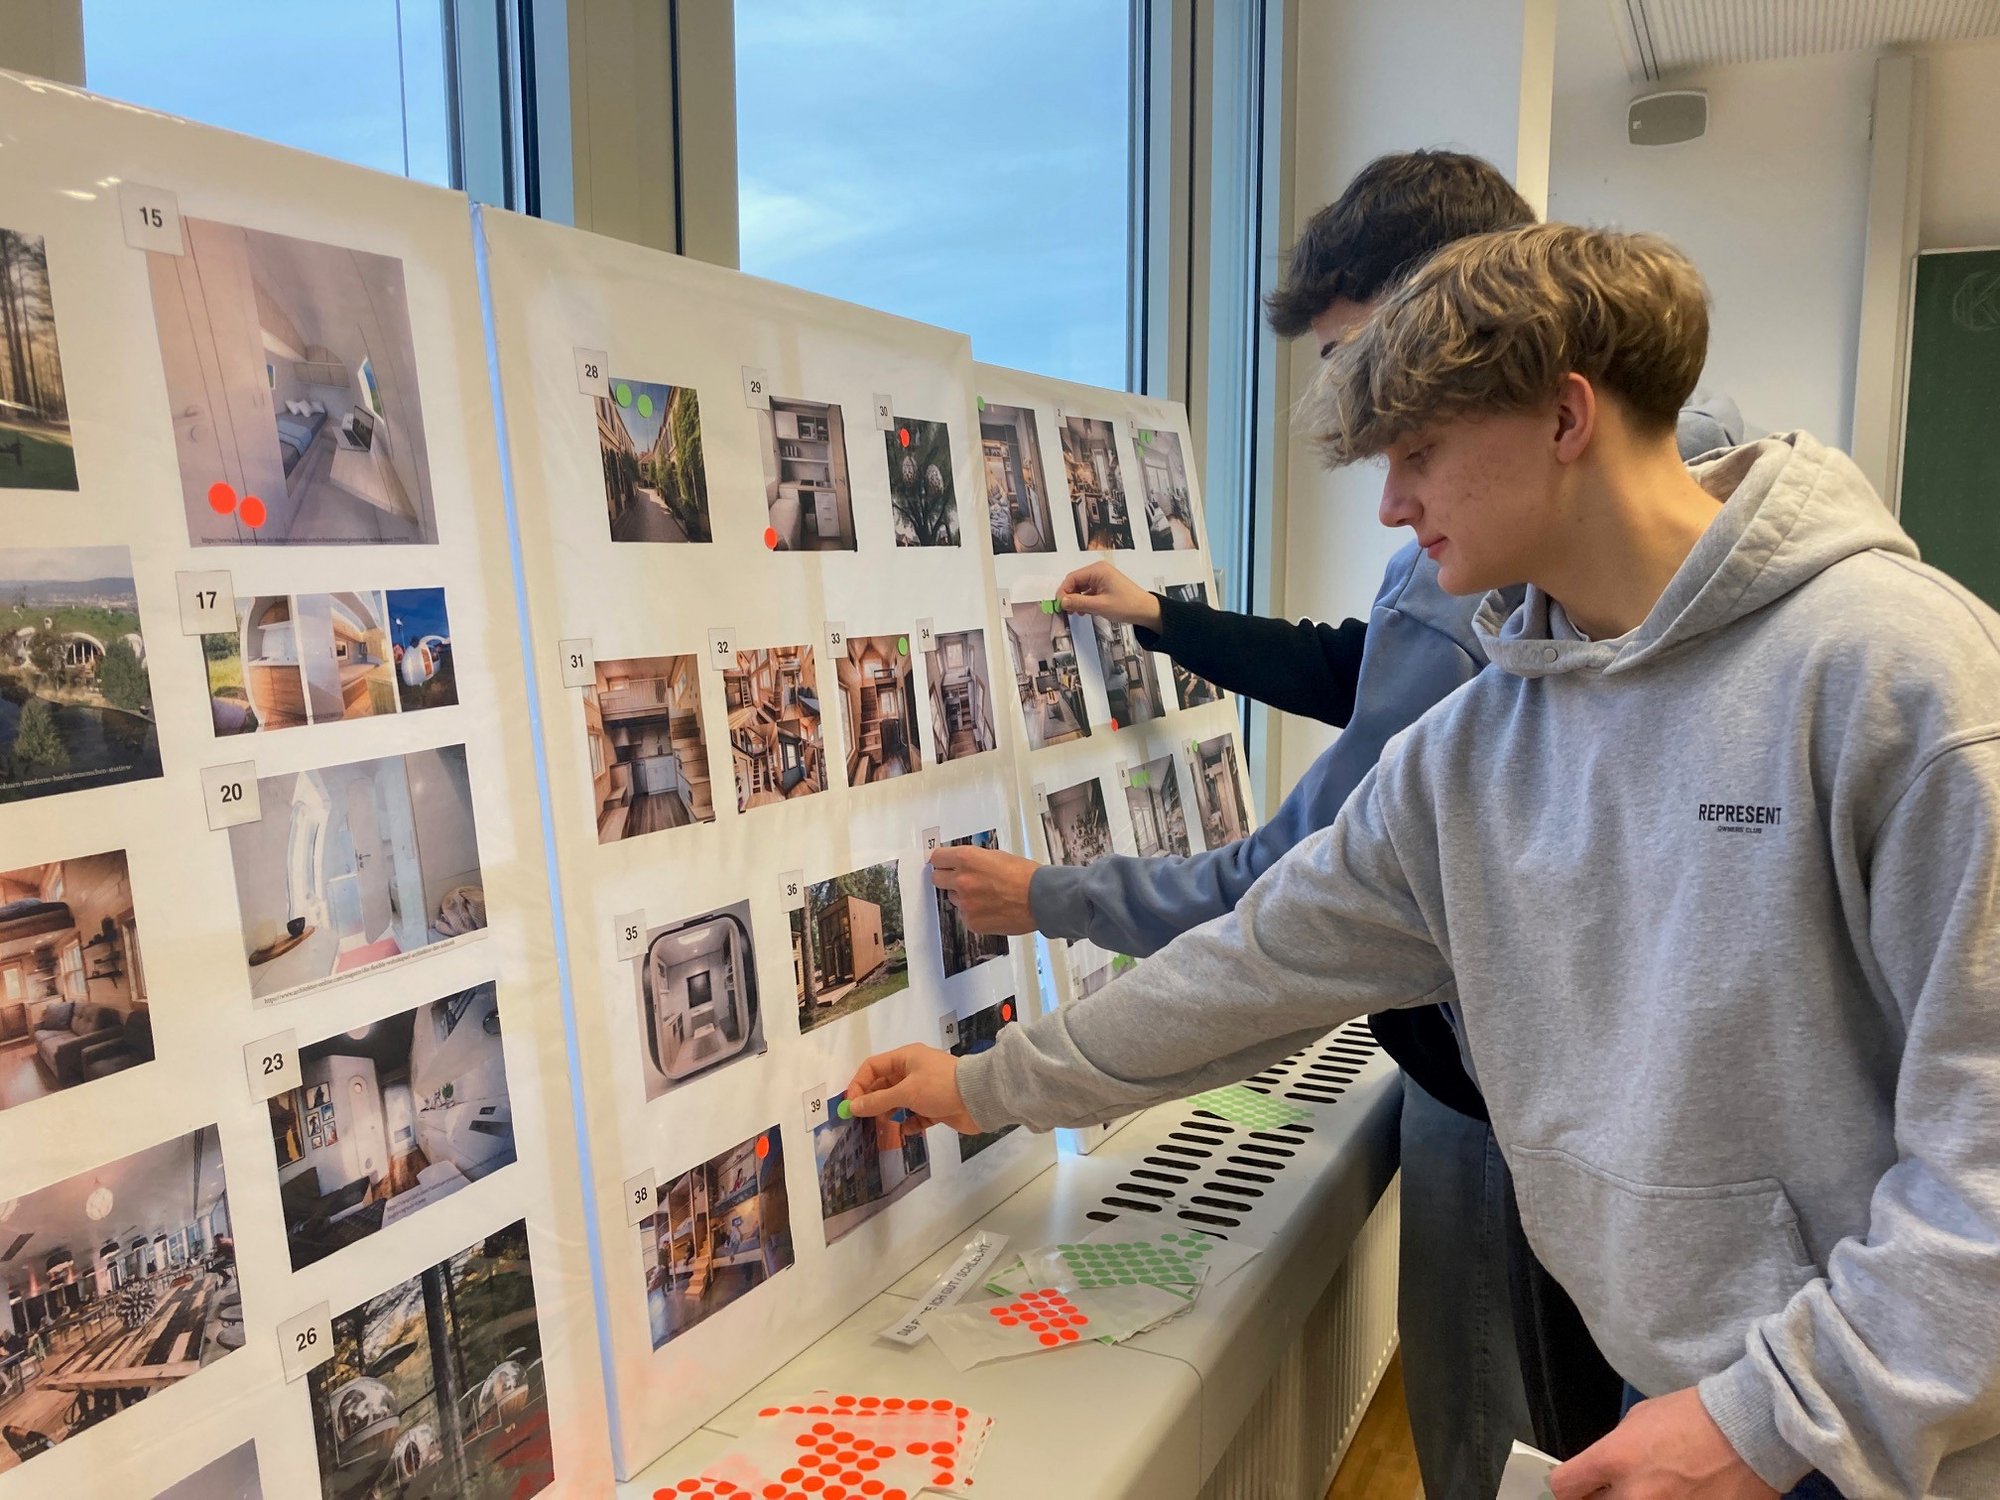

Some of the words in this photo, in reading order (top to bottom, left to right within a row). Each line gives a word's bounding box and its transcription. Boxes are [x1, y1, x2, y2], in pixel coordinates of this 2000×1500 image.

[139, 206, 163, 228] 15
[584, 363, 599, 379] 28
[750, 380, 762, 394] 29
[879, 405, 889, 417] 30
[195, 591, 218, 610] 17
[831, 632, 842, 645] 33
[921, 628, 932, 639] 34
[717, 641, 730, 654] 32
[570, 653, 585, 669] 31
[220, 782, 243, 803] 20
[1699, 804, 1782, 825] REPRESENT
[928, 838, 937, 850] 37
[787, 882, 799, 896] 36
[625, 925, 639, 941] 35
[945, 1023, 955, 1035] 40
[262, 1053, 285, 1076] 23
[810, 1098, 822, 1113] 39
[634, 1186, 649, 1205] 38
[897, 1324, 917, 1336] DAS
[929, 1294, 947, 1306] ICH
[941, 1280, 959, 1295] GUT
[295, 1327, 318, 1352] 26
